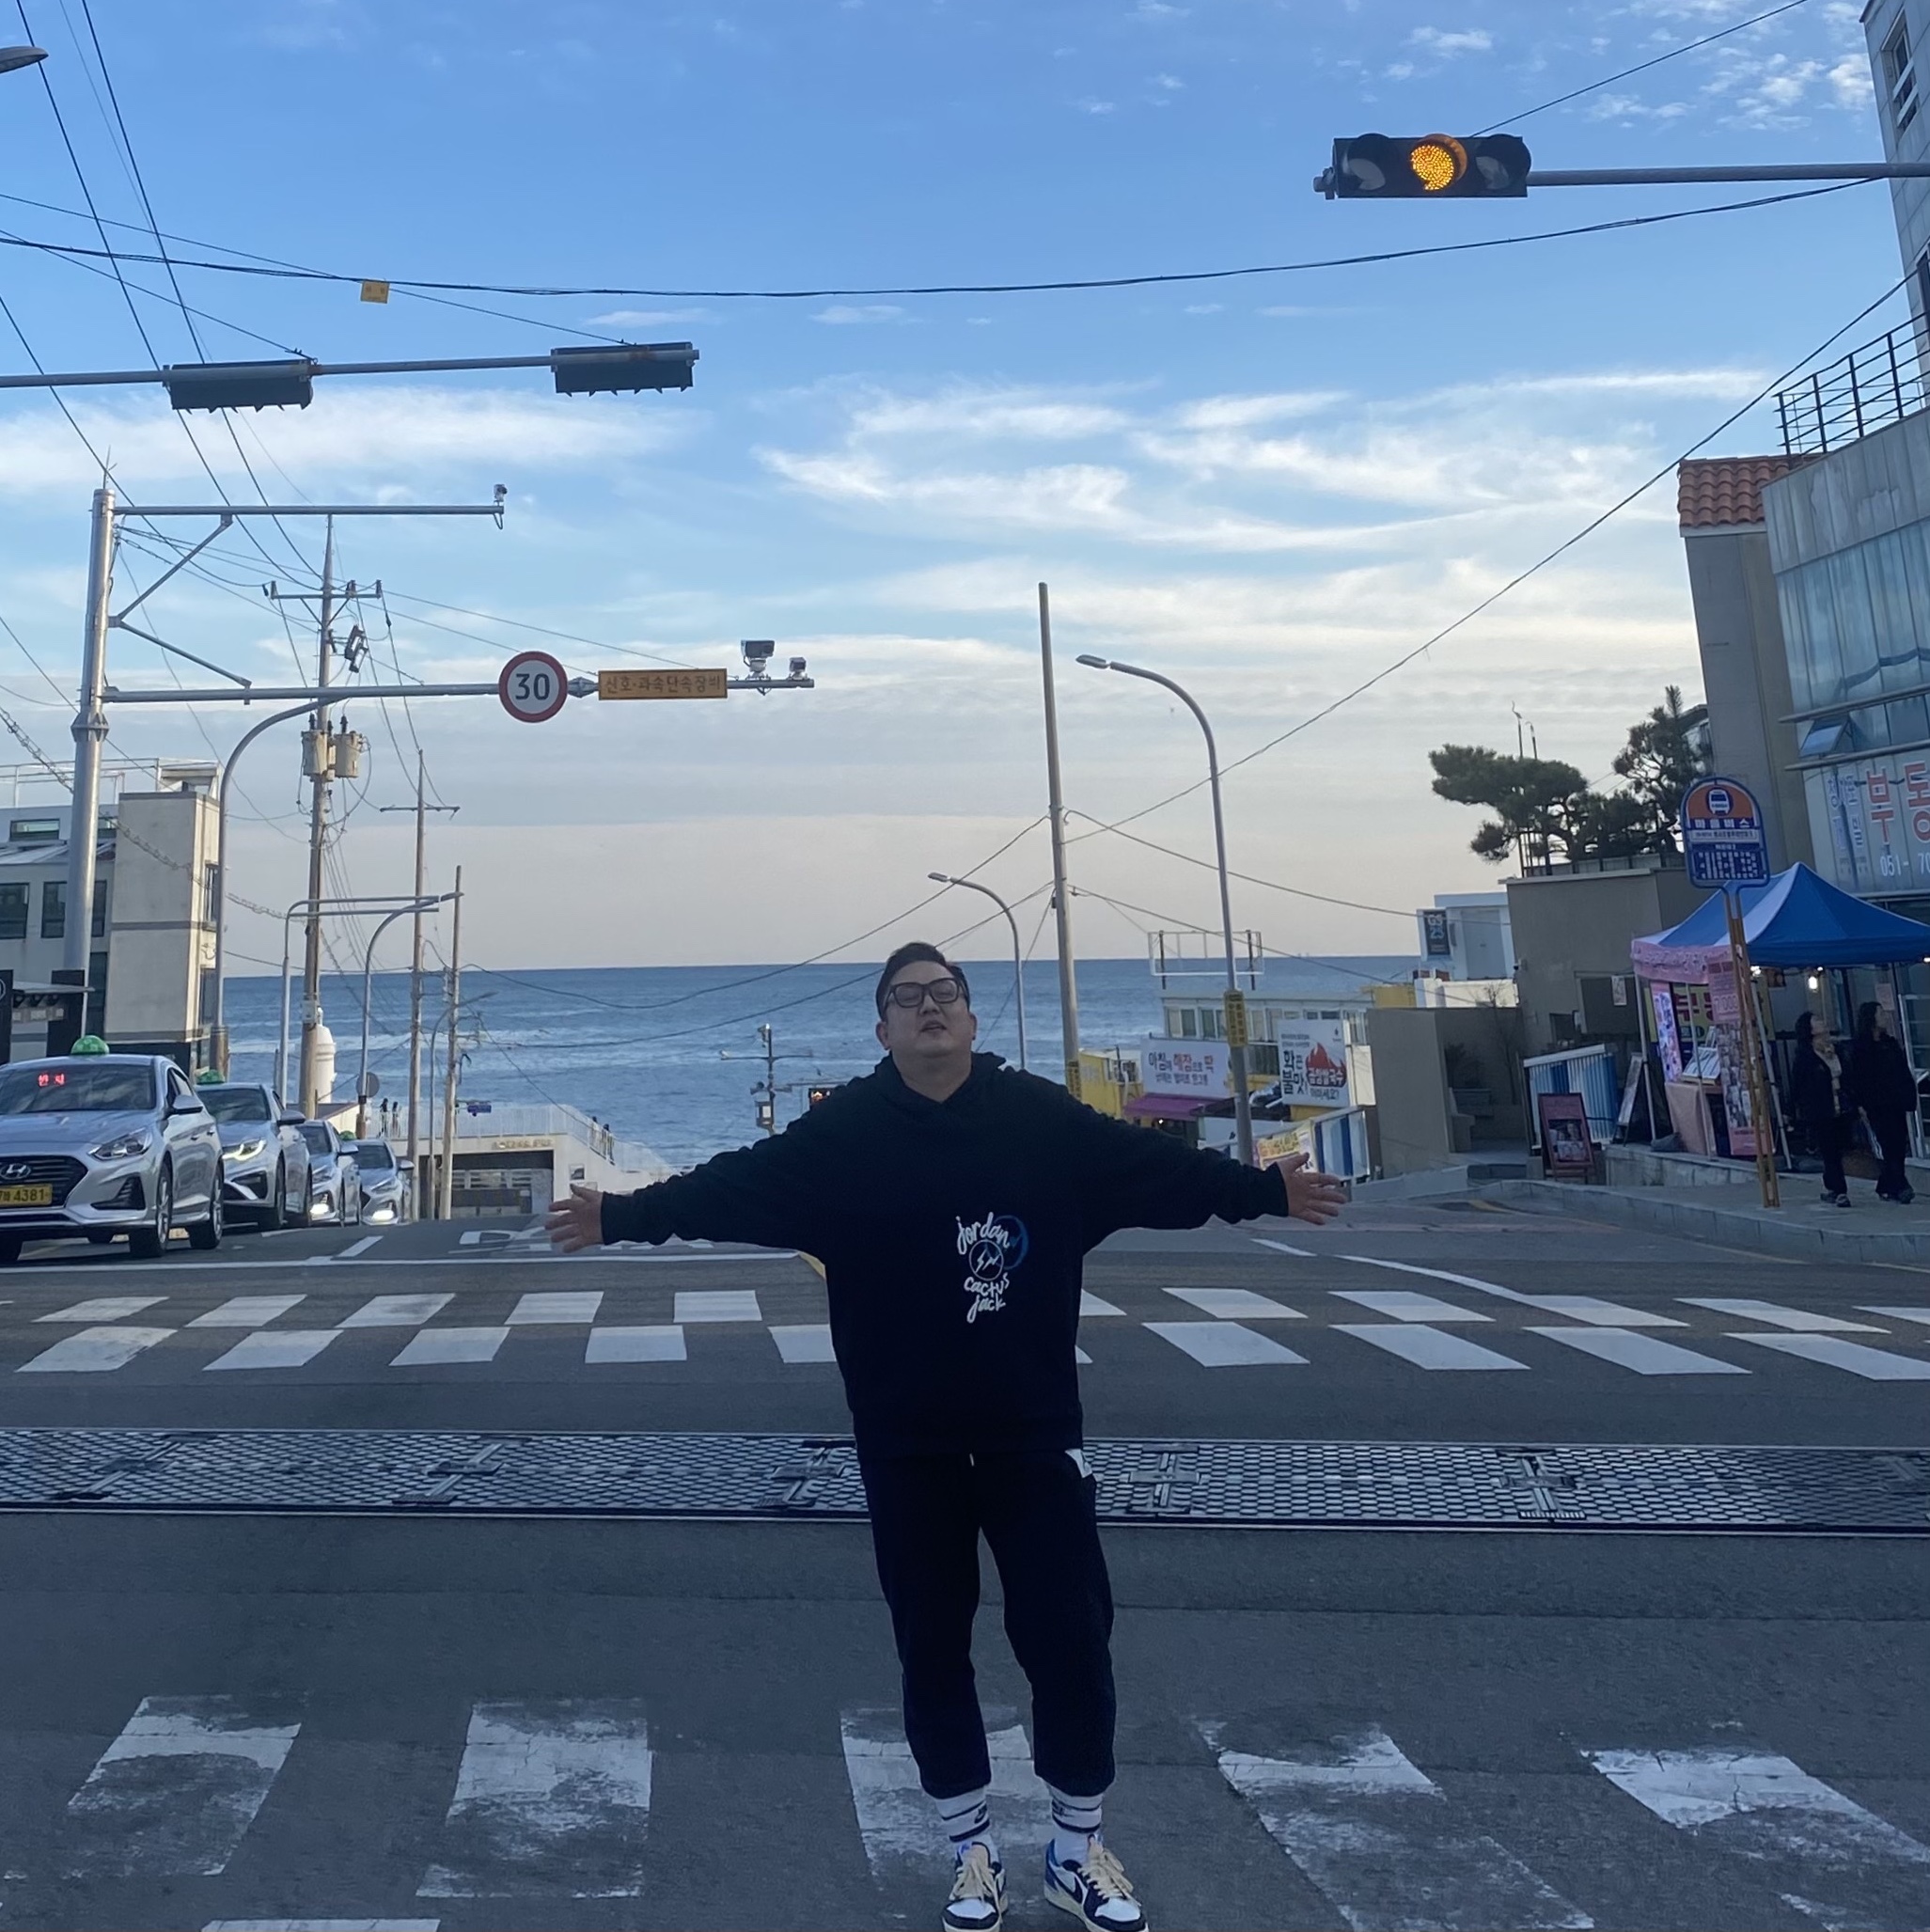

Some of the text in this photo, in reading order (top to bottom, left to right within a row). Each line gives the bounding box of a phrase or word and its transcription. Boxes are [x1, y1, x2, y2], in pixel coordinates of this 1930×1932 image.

[515, 672, 551, 701] 30
[13, 1188, 45, 1202] 4381
[964, 1272, 1010, 1297] cactus
[966, 1292, 1006, 1324] jack
